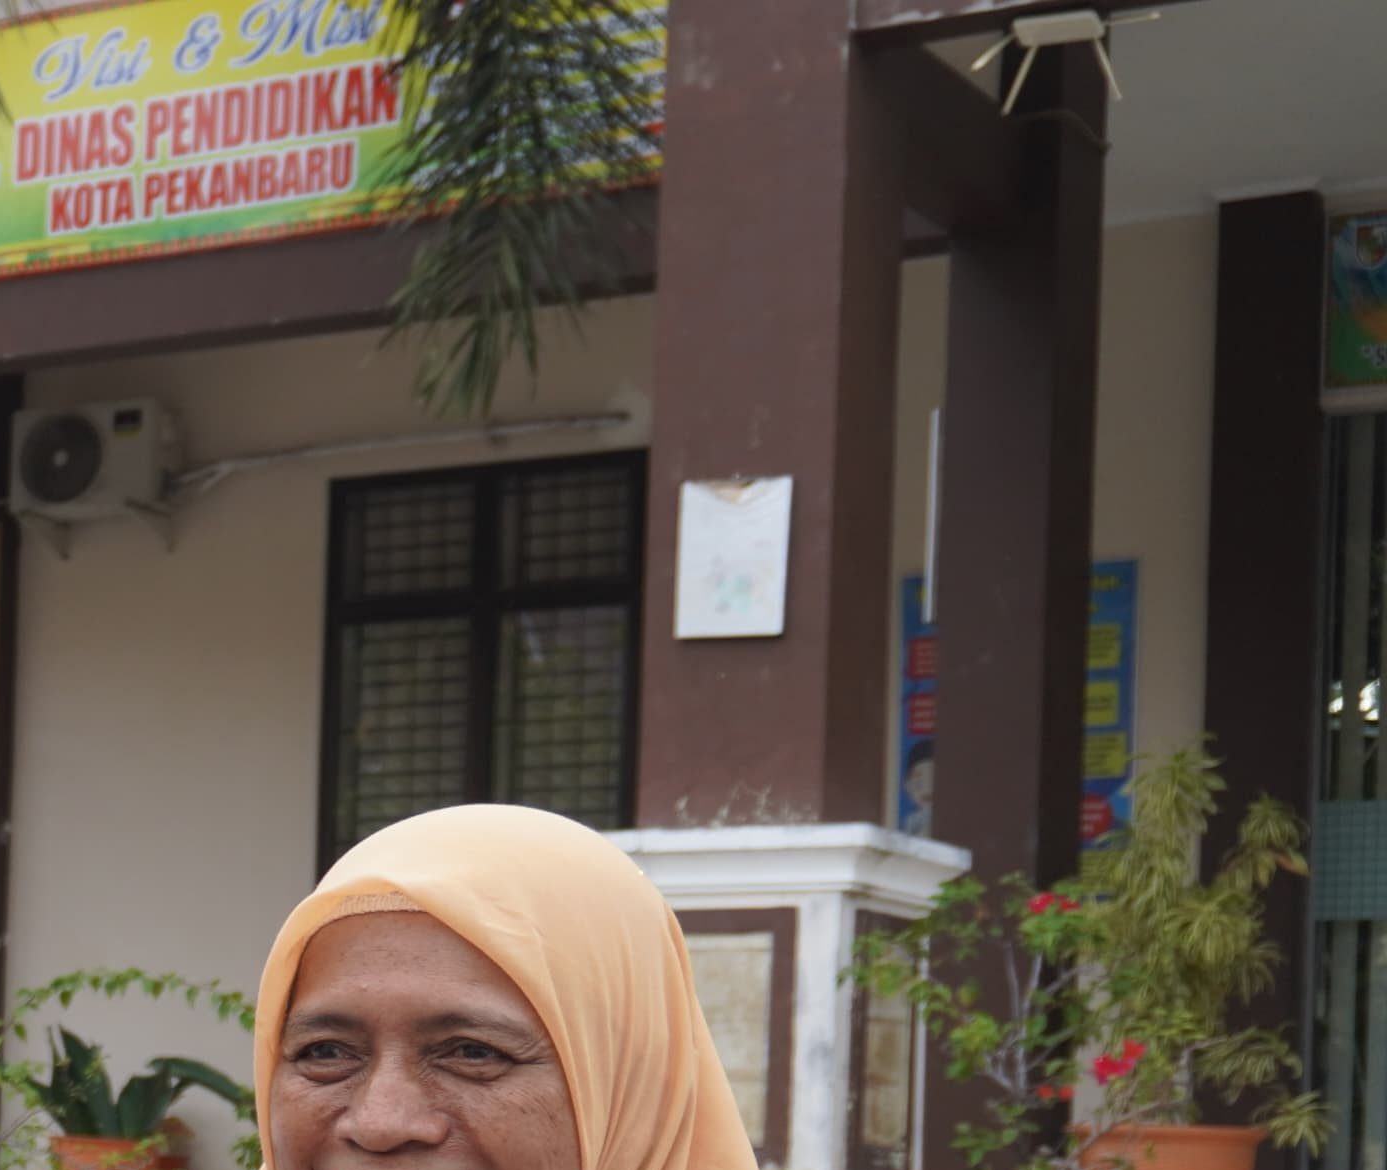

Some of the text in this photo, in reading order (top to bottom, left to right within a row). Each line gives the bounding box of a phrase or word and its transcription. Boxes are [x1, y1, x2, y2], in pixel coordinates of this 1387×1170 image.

[35, 29, 149, 101] Visi
[174, 14, 221, 73] &
[17, 107, 134, 181] DINAS
[145, 61, 399, 161] PENDIDIKAN
[51, 142, 355, 232] KOTA PEKANBARU
